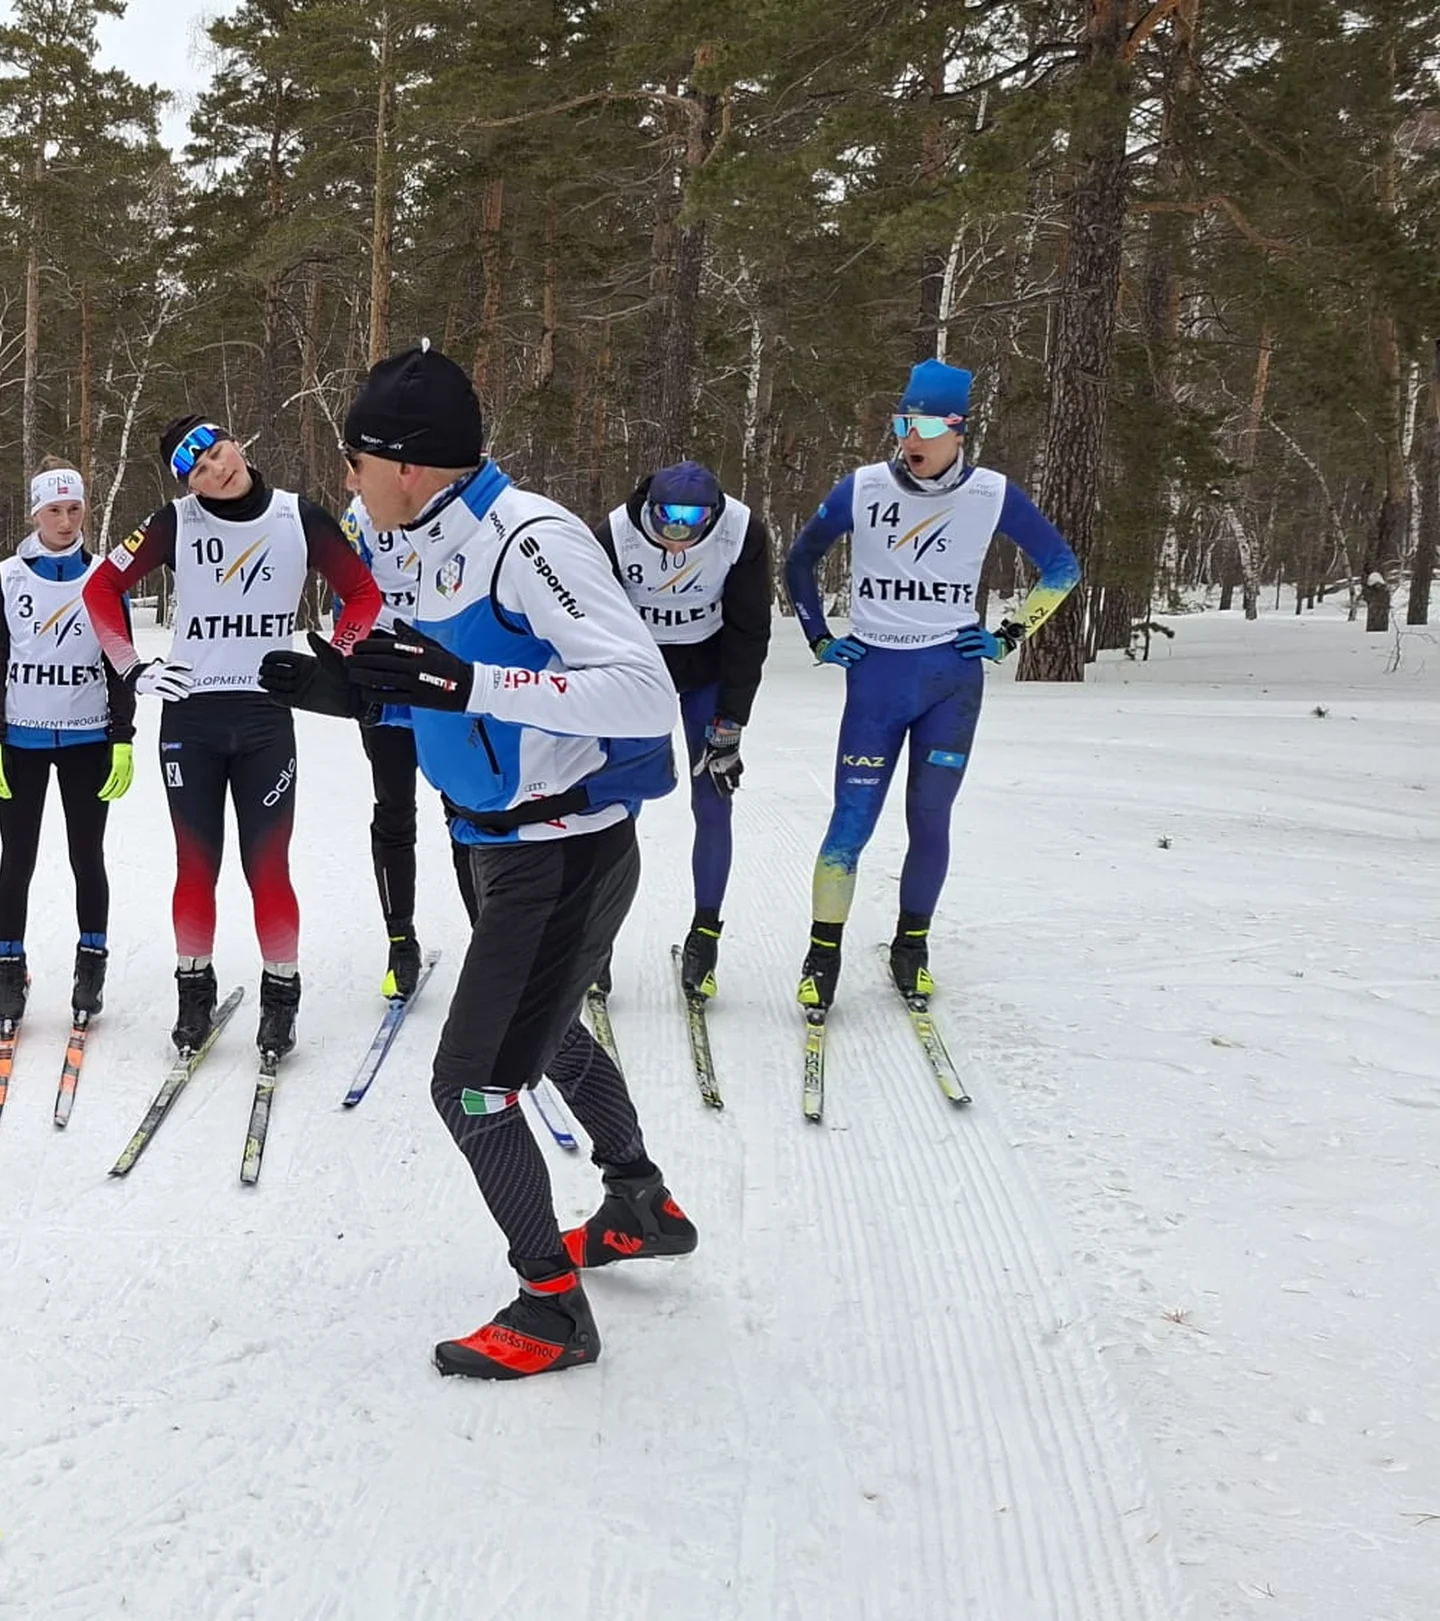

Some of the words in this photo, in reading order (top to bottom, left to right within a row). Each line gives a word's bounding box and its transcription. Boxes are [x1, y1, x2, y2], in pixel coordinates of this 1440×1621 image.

[867, 502, 900, 528] 14
[192, 538, 224, 564] 10
[378, 531, 394, 551] 9
[627, 564, 644, 584] 8
[533, 555, 585, 620] sportful
[858, 577, 974, 604] ATHLETE
[18, 594, 34, 618] 3
[639, 602, 717, 627] THLE
[186, 611, 295, 640] ATHLETE
[334, 621, 363, 650] RGE
[193, 676, 254, 687] LOPMENT
[842, 754, 886, 768] KAZ
[263, 757, 296, 807] odlo
